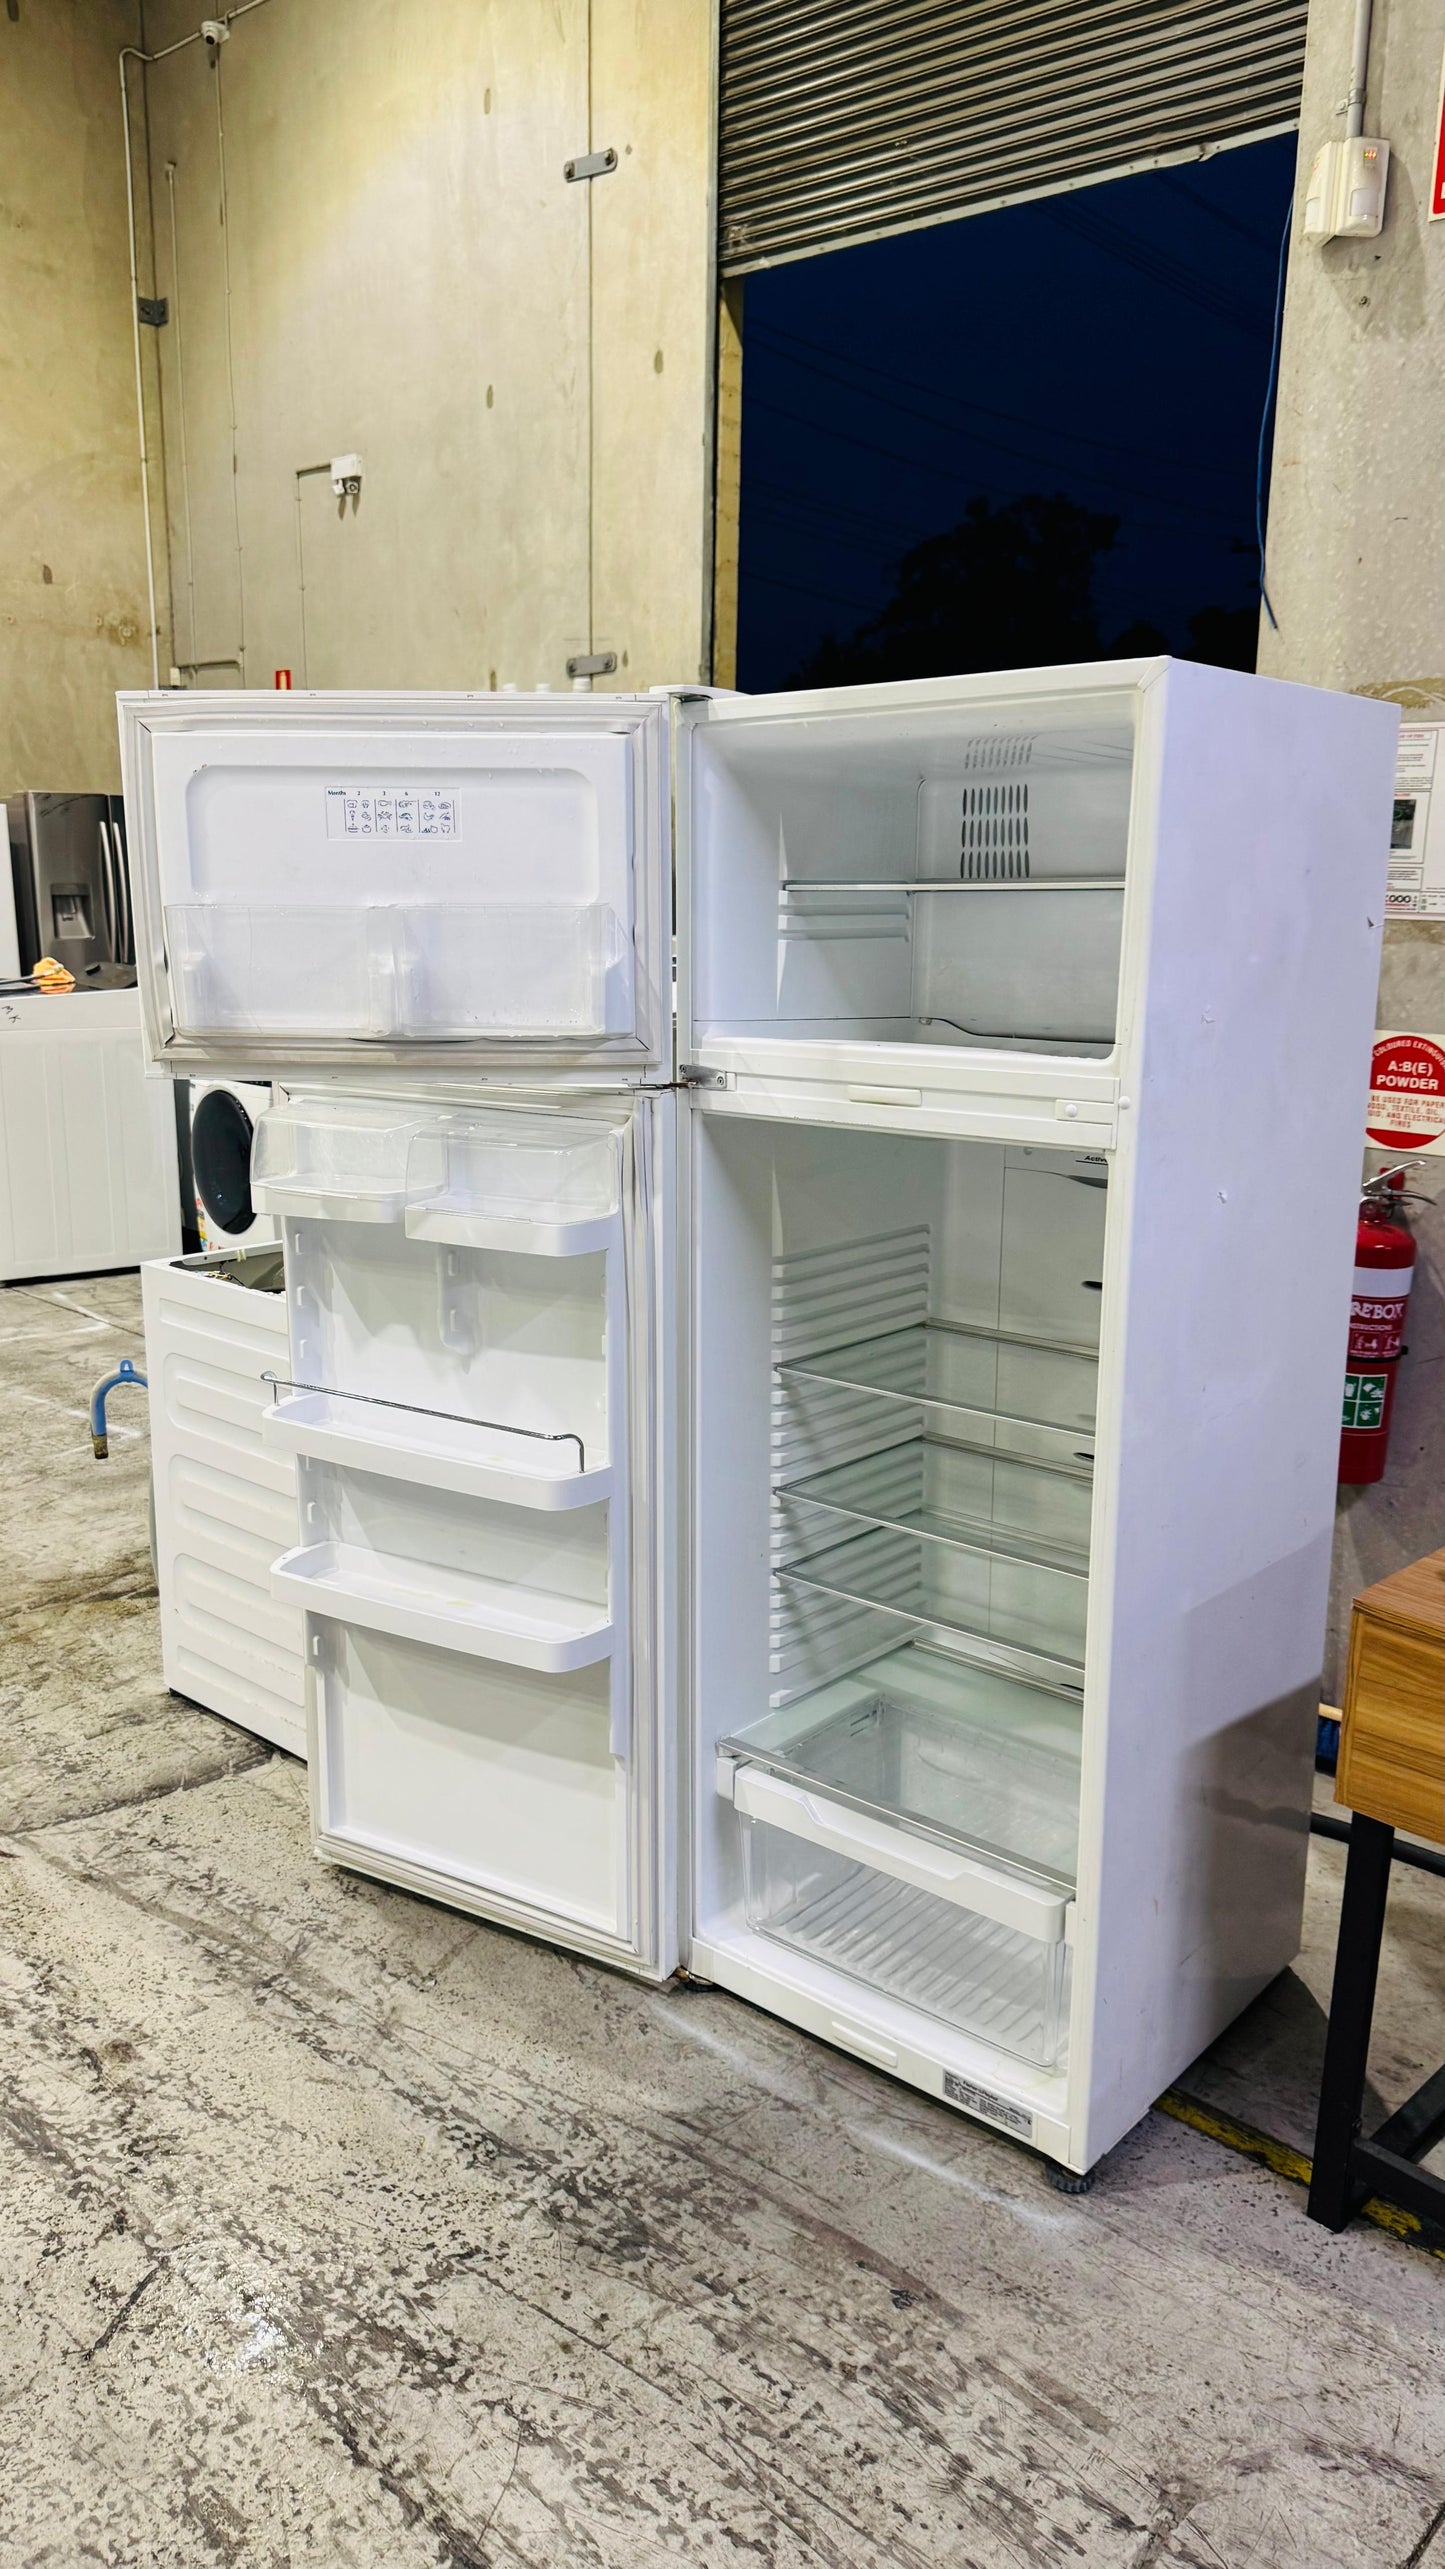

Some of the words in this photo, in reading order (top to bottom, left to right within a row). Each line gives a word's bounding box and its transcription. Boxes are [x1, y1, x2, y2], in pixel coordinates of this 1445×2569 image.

[1387, 1060, 1433, 1077] A:B(E)
[1376, 1074, 1439, 1091] POWDER
[1382, 1096, 1402, 1104] USED
[1404, 1098, 1418, 1106] FOR
[1390, 1119, 1411, 1128] FIRES
[1351, 1302, 1404, 1319] REBOX
